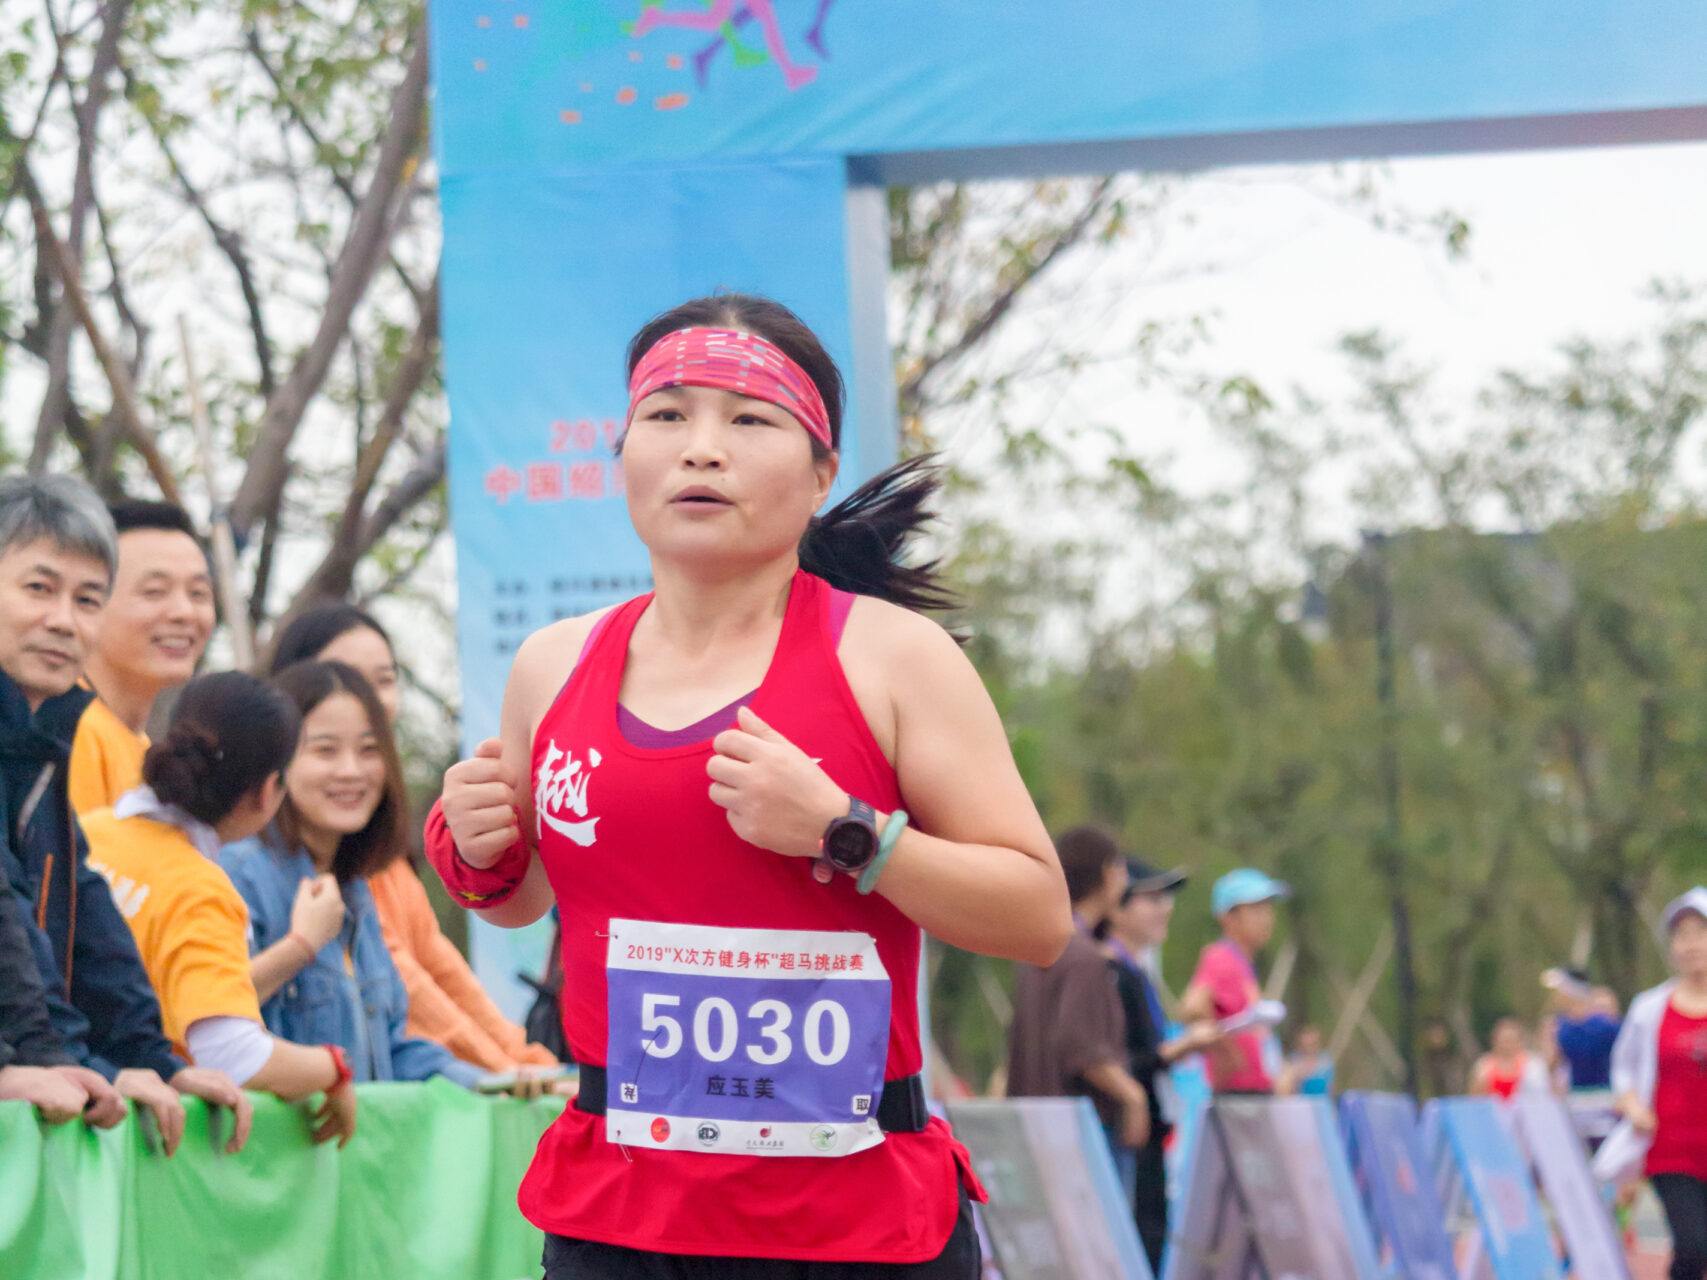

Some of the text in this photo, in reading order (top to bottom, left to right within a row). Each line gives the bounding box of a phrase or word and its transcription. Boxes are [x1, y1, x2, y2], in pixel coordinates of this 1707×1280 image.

[551, 420, 627, 452] 201
[641, 993, 850, 1065] 5030
[706, 1075, 776, 1100] 应玉美
